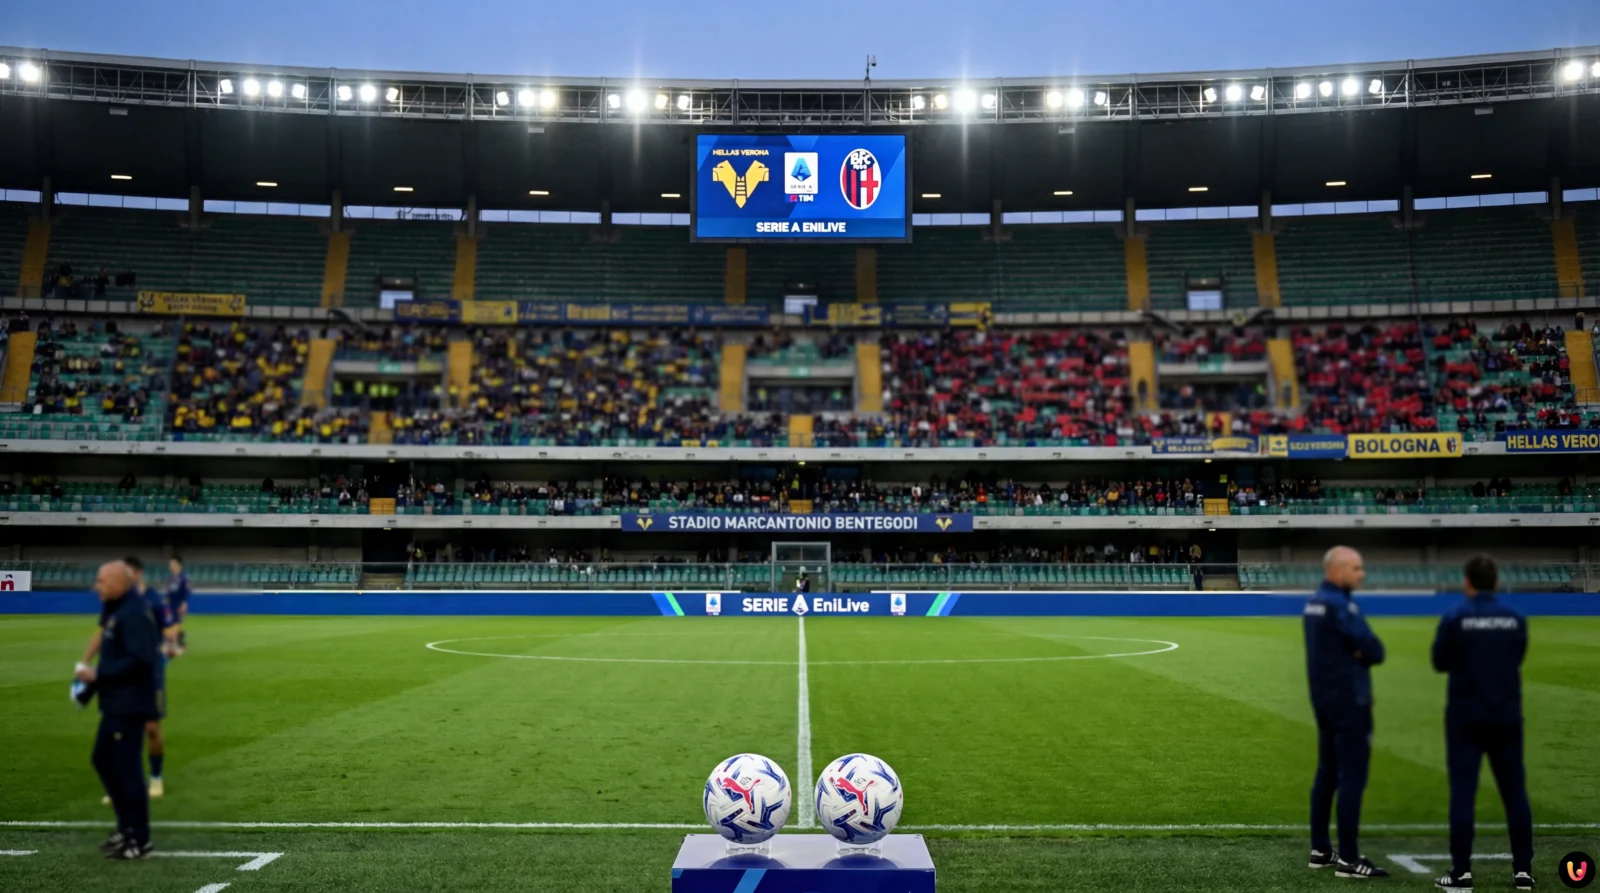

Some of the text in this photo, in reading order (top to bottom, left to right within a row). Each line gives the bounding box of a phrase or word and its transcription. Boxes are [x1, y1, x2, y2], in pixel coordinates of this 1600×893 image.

[798, 194, 814, 202] TIM
[756, 221, 847, 233] SERIE A ENILIVE
[1354, 438, 1441, 454] BOLOGNA
[1507, 433, 1600, 450] HELLAS VERO
[668, 515, 919, 530] STADIO MARCANTONIO BENTEGODI
[742, 598, 789, 613] SERIE
[813, 597, 870, 613] EniLive
